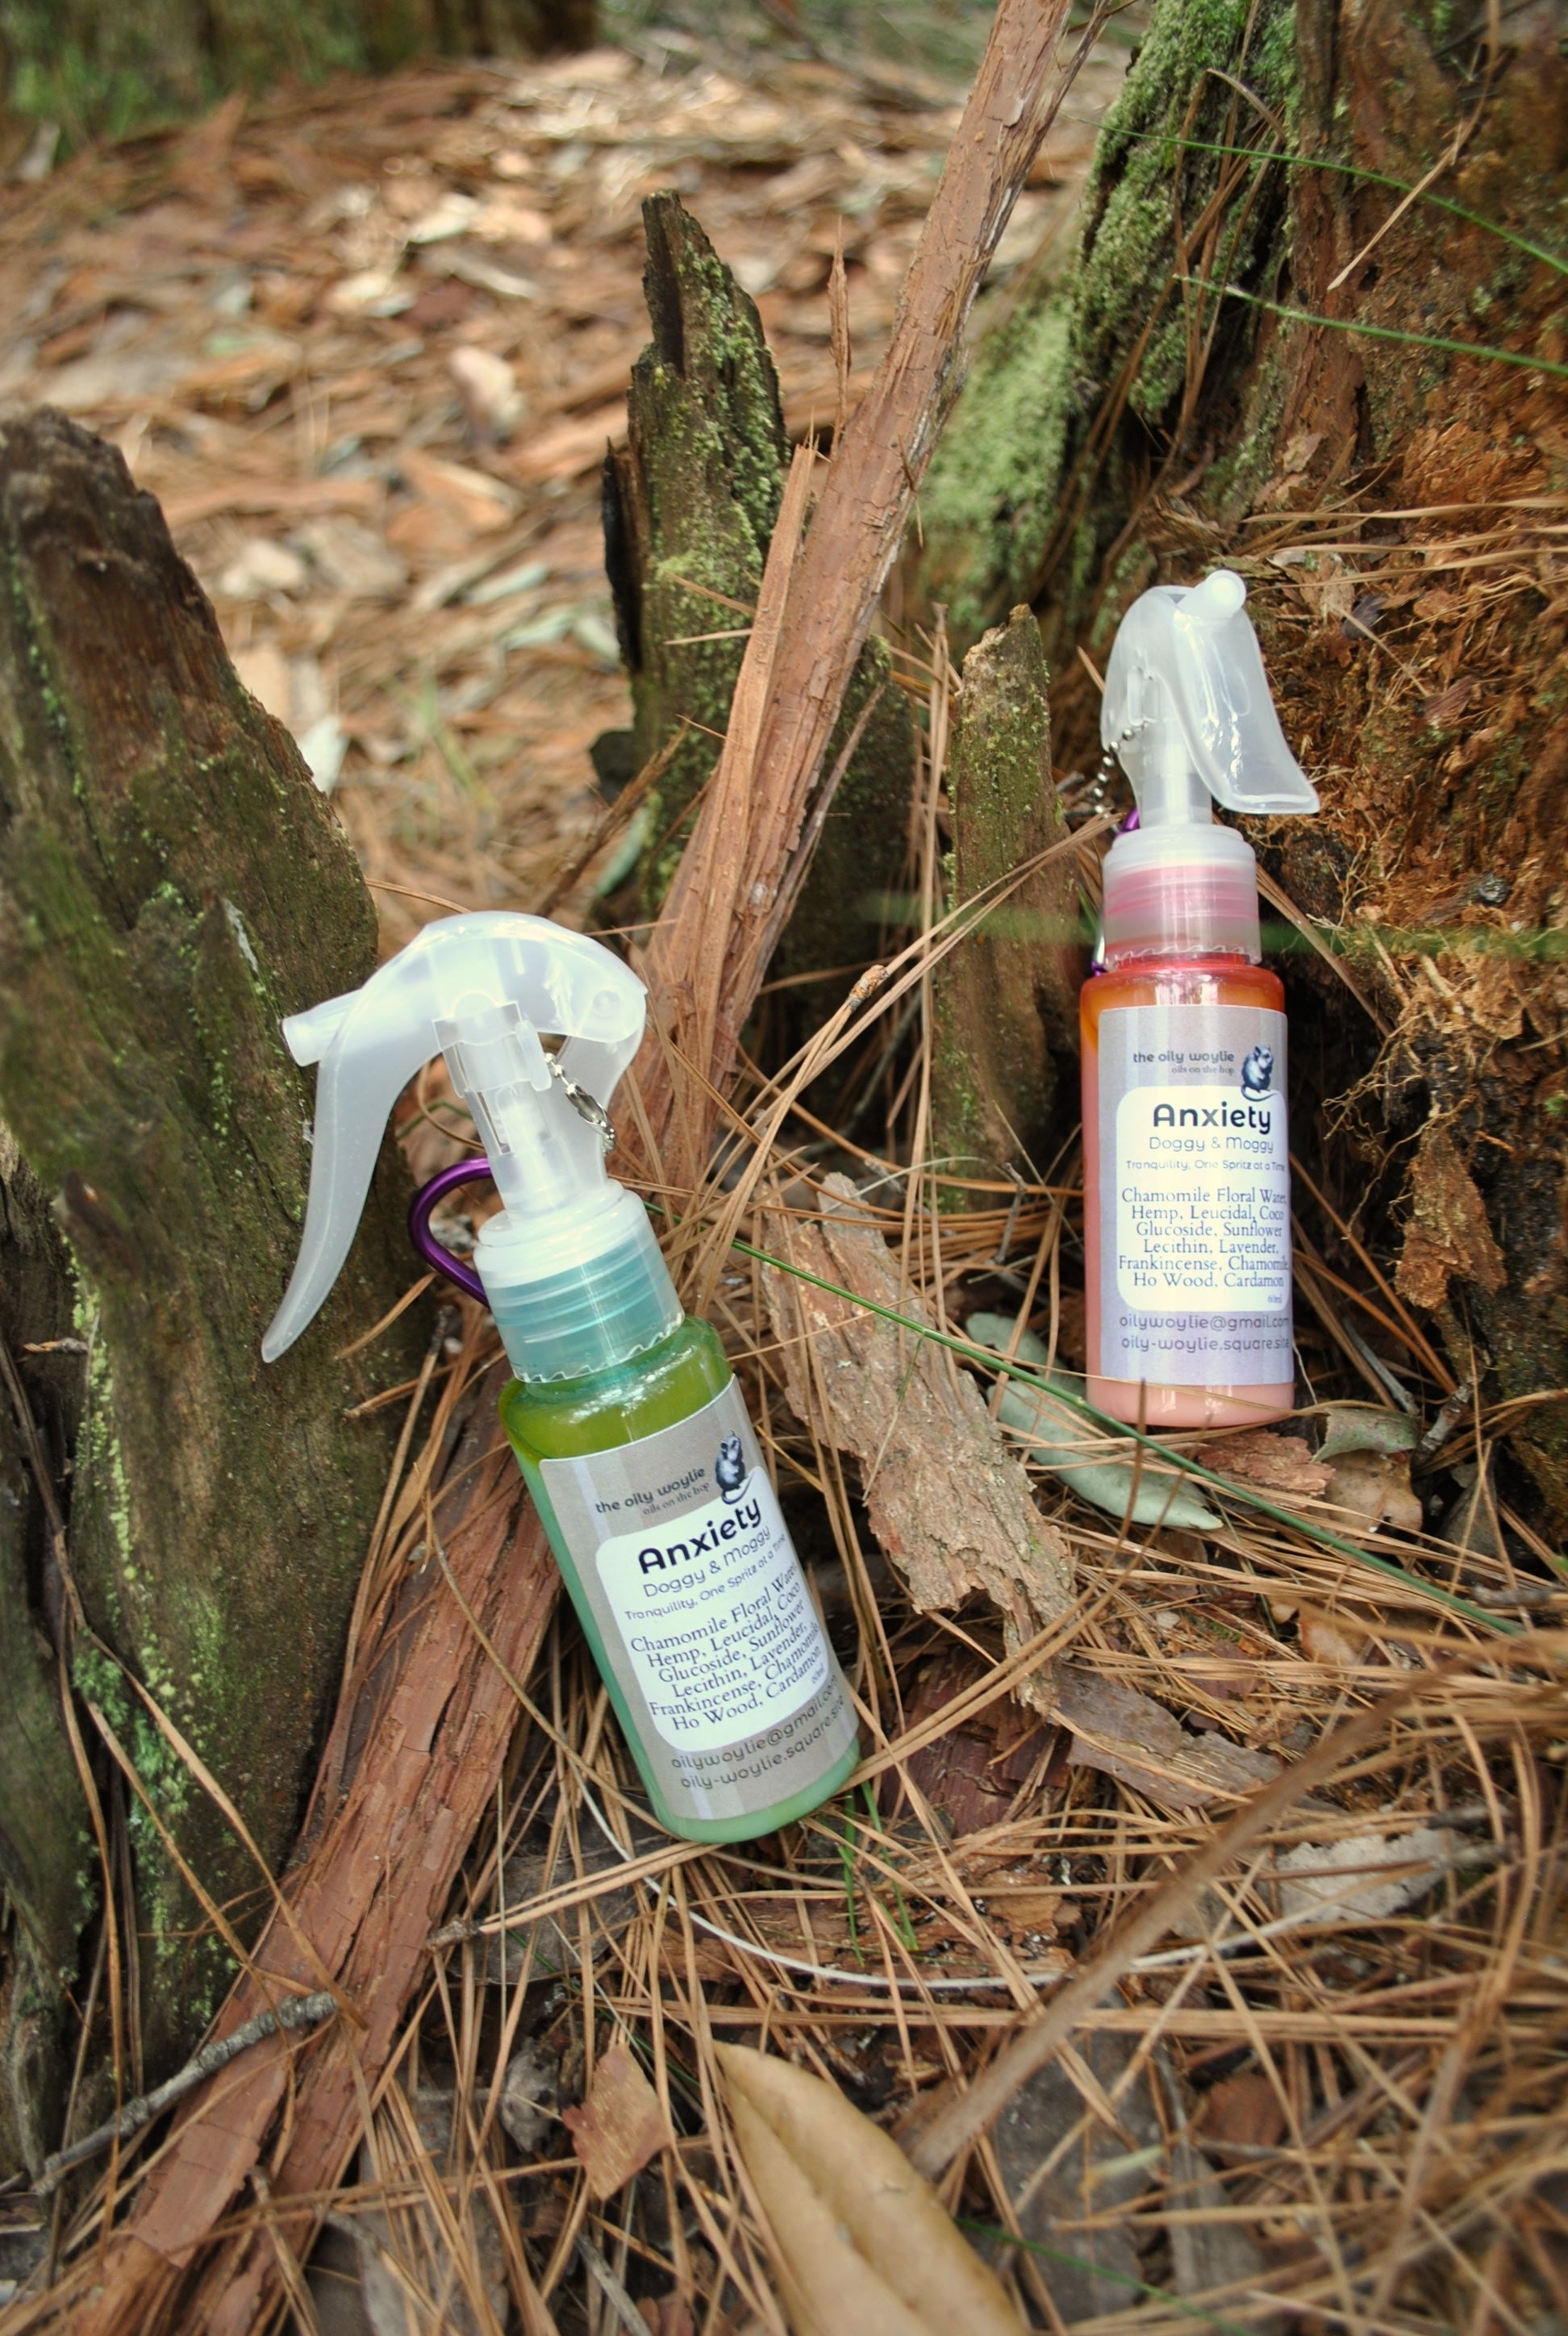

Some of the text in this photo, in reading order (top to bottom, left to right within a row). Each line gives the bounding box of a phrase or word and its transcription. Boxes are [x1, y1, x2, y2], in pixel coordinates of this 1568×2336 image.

[1133, 1050, 1234, 1064] the oily woylie
[1203, 1066, 1216, 1074] the
[1219, 1066, 1234, 1076] hop
[1153, 1101, 1270, 1135] Anxiety
[1149, 1137, 1274, 1153] Doggy & Moggy
[1126, 1160, 1191, 1170] Tranquility,
[1195, 1160, 1218, 1169] One
[1223, 1160, 1251, 1170] Spritz
[1253, 1162, 1263, 1170] at
[1121, 1187, 1211, 1203] Chamomile
[1216, 1187, 1255, 1203] Floral
[1132, 1205, 1284, 1224] Hemp, Leucidal, Coco
[1136, 1221, 1282, 1237] Glucoside, Sunflower
[1144, 1238, 1279, 1254] Lecithin, Lavender,
[1118, 1255, 1222, 1271] Frankincense,
[1133, 1272, 1284, 1287] Ho Wood, Cardamon
[595, 1468, 705, 1513] the oily woylie
[663, 1500, 675, 1508] on
[676, 1491, 692, 1503] the
[693, 1483, 710, 1495] hop
[638, 1497, 761, 1575] Anxiety
[643, 1525, 771, 1598] Doggy & Moggy
[625, 1596, 699, 1621] Tranquility,
[699, 1584, 726, 1601] One
[728, 1565, 757, 1589] Spritz
[758, 1556, 768, 1568] at
[768, 1550, 774, 1559] a
[631, 1616, 728, 1653] Chamomile
[731, 1587, 772, 1624] Floral
[646, 1583, 800, 1668] Hemp, Leucidal, Coco
[658, 1599, 805, 1683] Glucoside, Sunflower
[672, 1622, 807, 1698] Lecithin, Lavender,
[649, 1677, 763, 1717] Frankincense,
[672, 1646, 821, 1730] Ho Wood, Cardamon
